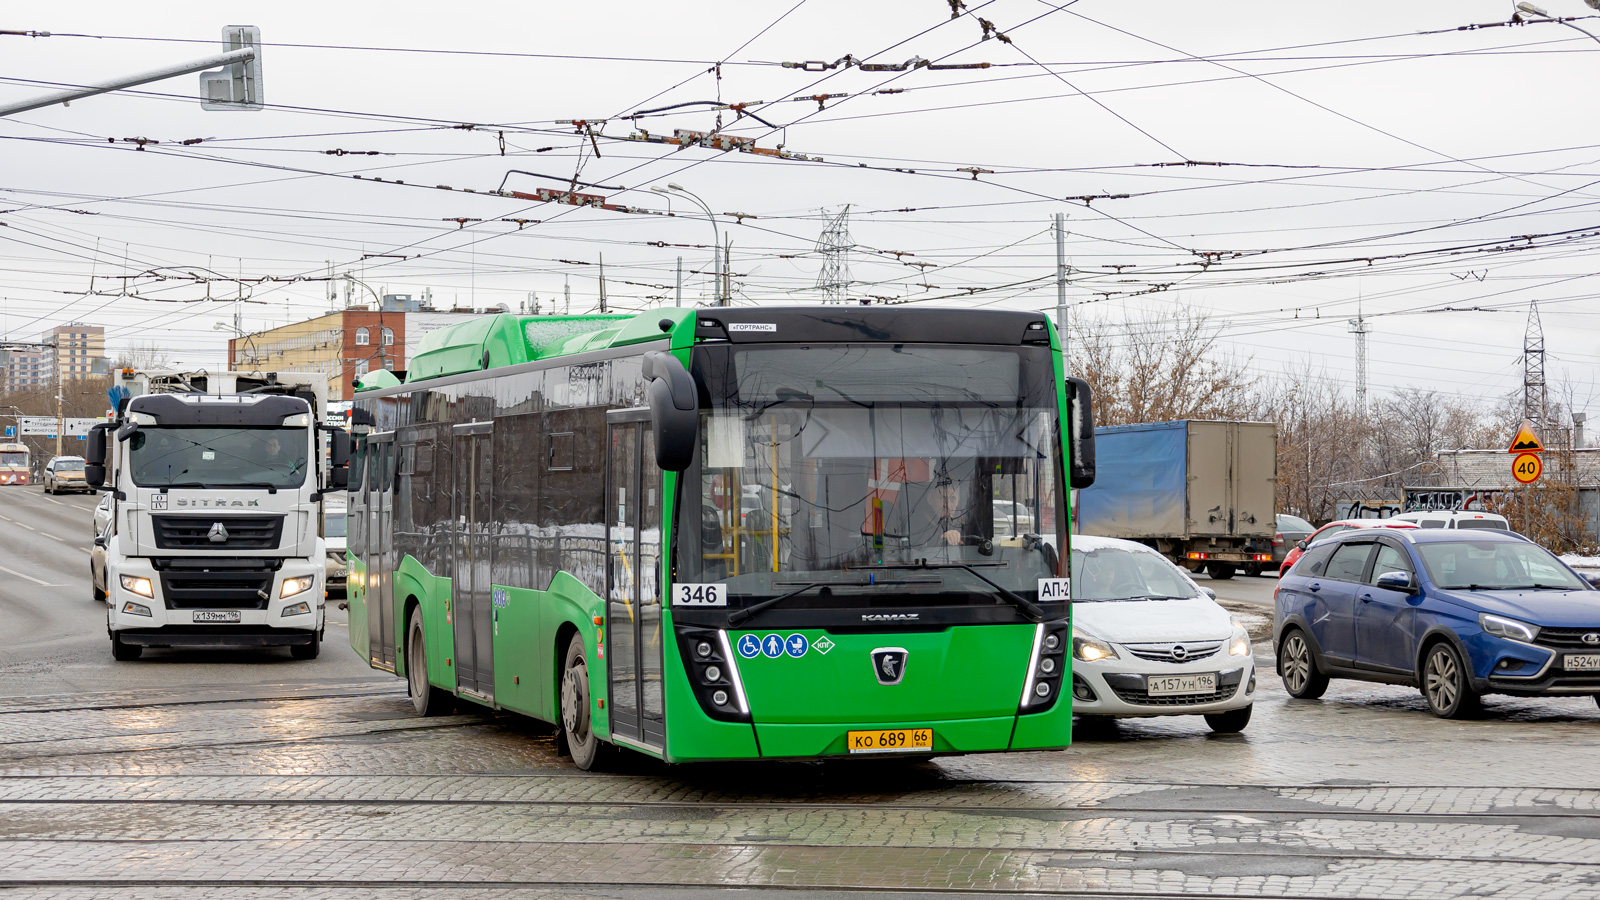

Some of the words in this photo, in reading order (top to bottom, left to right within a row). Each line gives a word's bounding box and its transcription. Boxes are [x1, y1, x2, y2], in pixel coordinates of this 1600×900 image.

[1517, 461, 1536, 475] 40
[176, 498, 260, 507] SITRAK
[681, 585, 717, 603] 346
[1041, 581, 1069, 597] АП-2
[861, 613, 920, 622] KAMAZ
[1567, 656, 1600, 667] Н524У
[1197, 676, 1213, 686] 196
[879, 732, 906, 747] 689
[914, 730, 928, 742] 66
